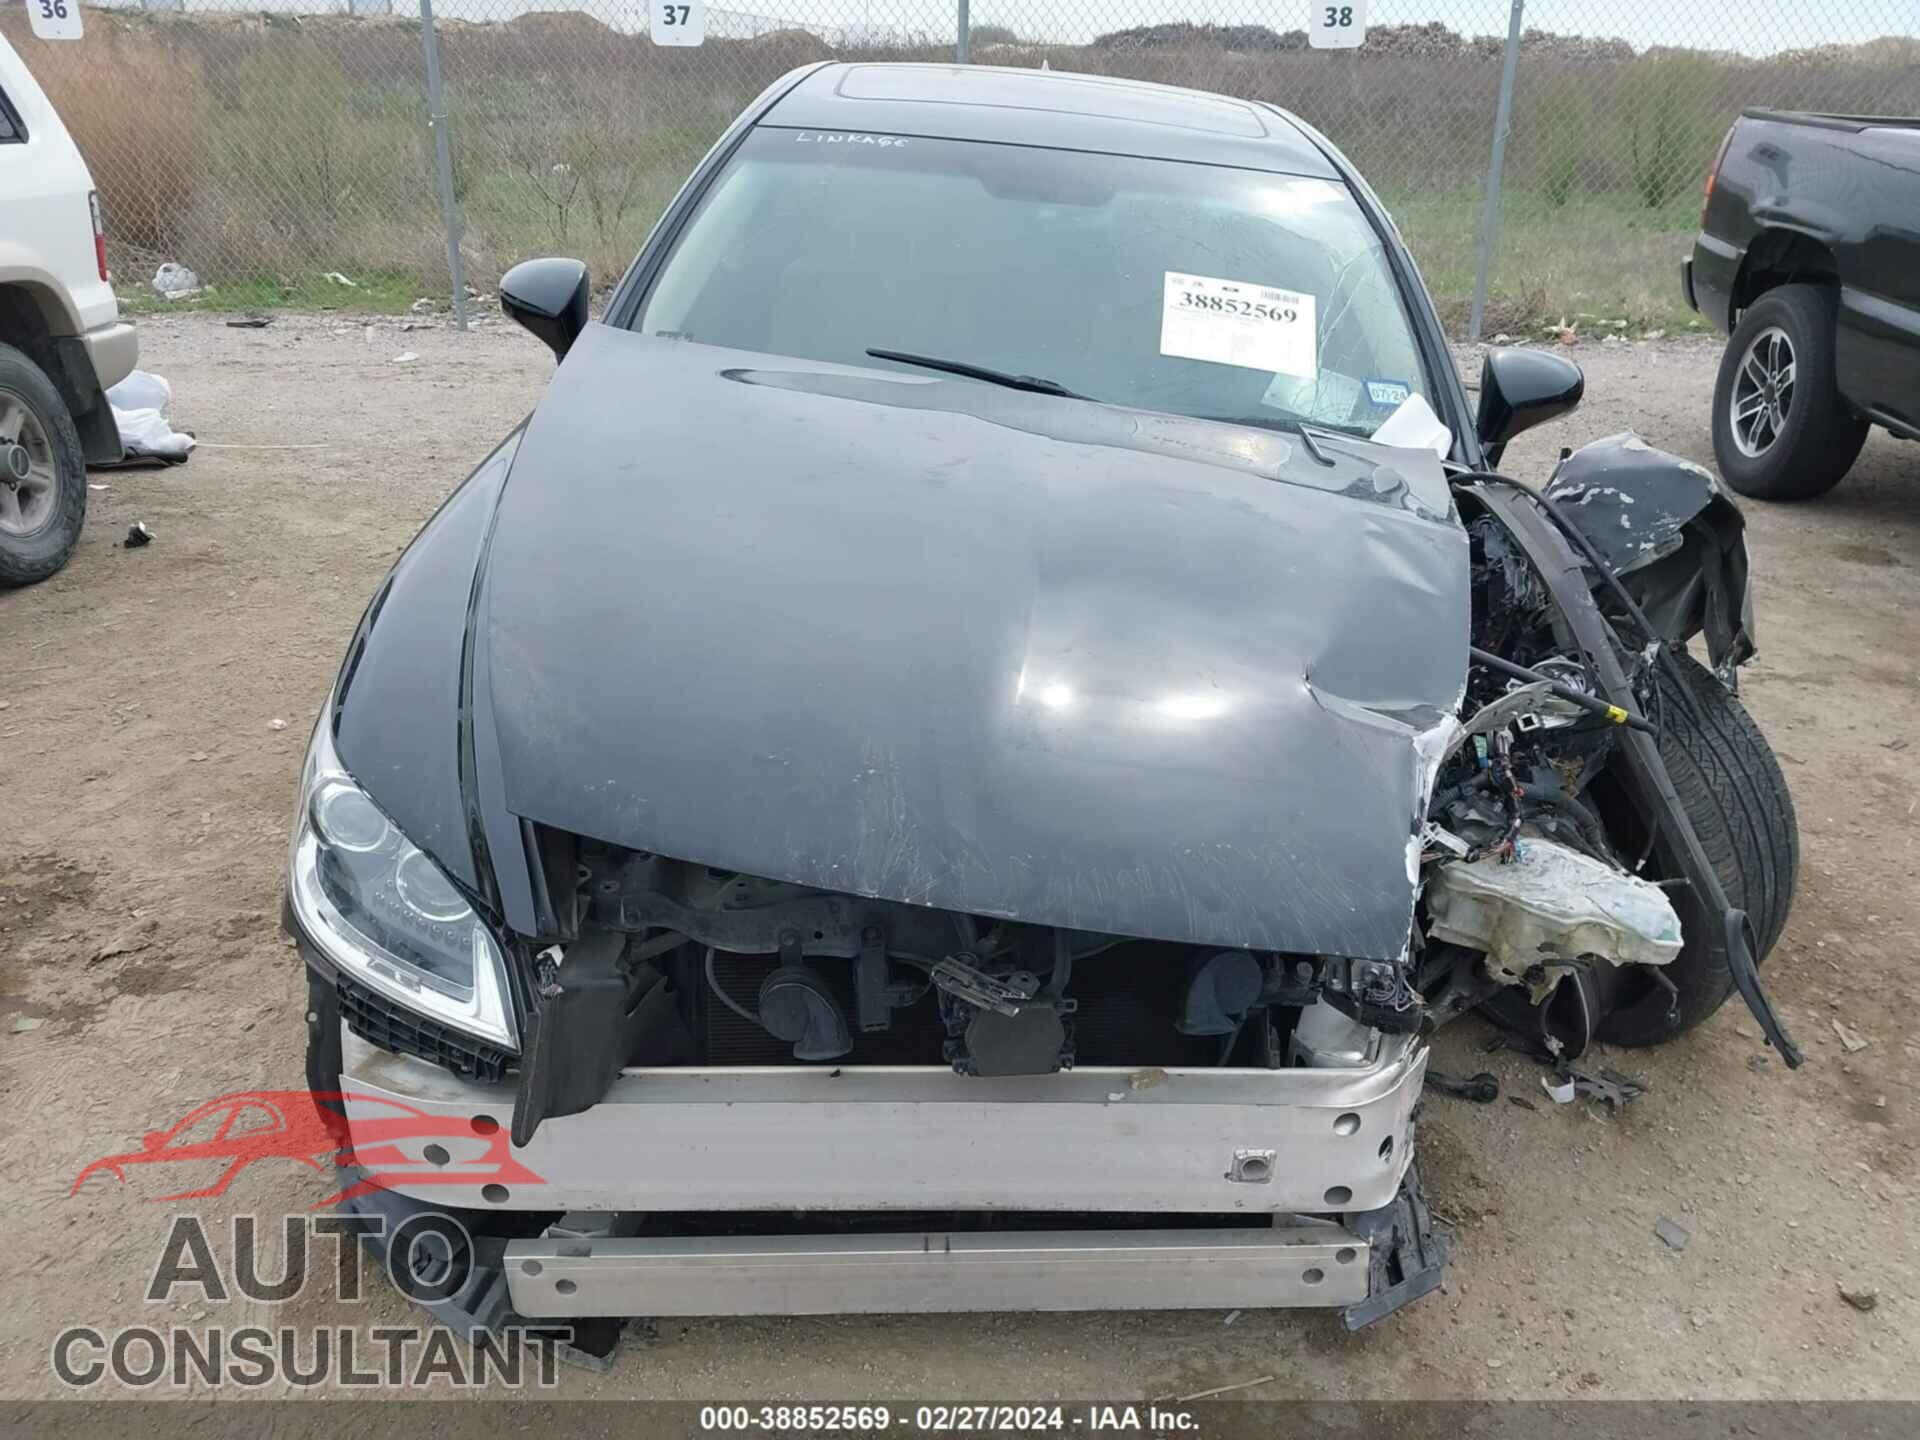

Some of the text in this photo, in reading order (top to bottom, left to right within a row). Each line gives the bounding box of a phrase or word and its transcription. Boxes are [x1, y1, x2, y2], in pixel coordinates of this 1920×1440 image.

[40, 0, 67, 19] 36
[663, 5, 690, 26] 37
[1323, 6, 1352, 28] 38
[795, 132, 909, 148] LINKAGE
[1178, 291, 1298, 324] 38852569
